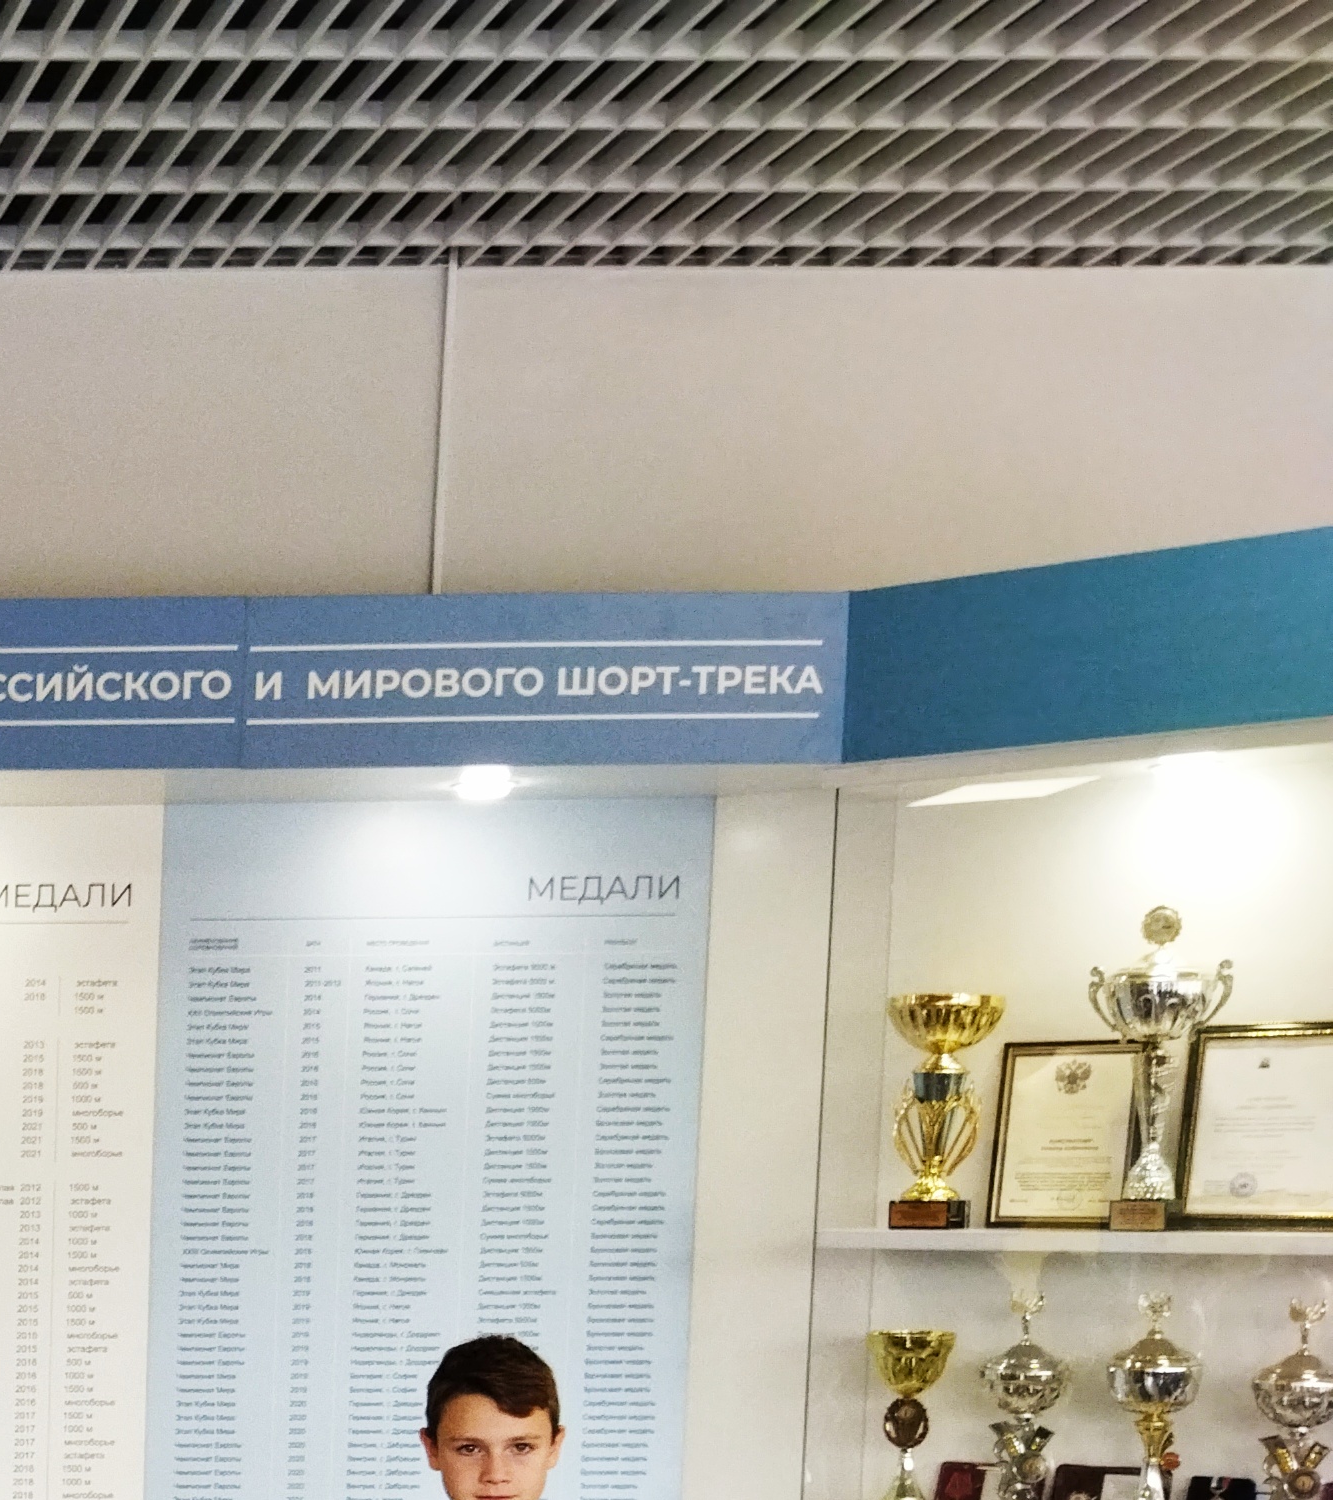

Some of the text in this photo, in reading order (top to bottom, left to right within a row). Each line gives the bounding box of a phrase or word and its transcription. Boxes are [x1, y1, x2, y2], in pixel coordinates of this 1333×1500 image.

[254, 669, 282, 701] И
[306, 665, 544, 700] МИРОВОГО
[557, 662, 823, 700] ШОРТ-ТРЕКА
[527, 873, 682, 908] МЕДАЛИ
[25, 979, 46, 987] 2014
